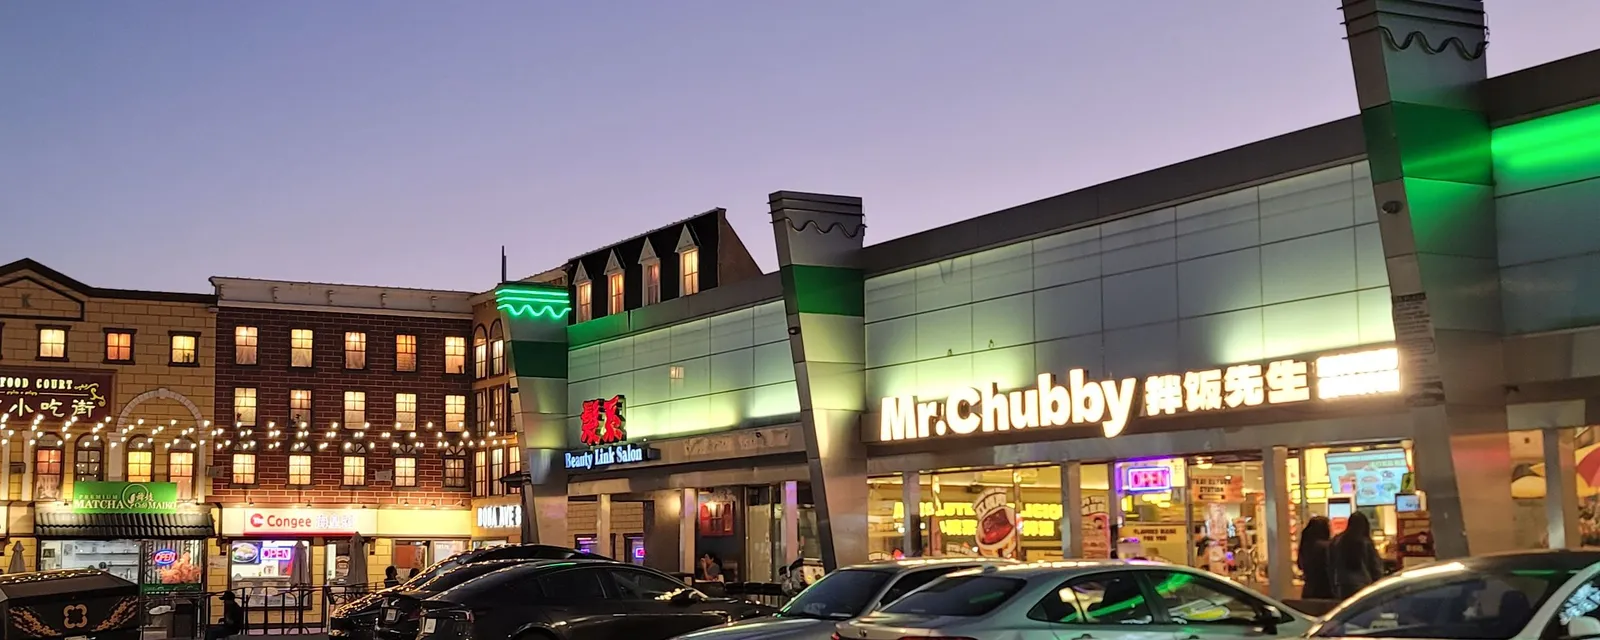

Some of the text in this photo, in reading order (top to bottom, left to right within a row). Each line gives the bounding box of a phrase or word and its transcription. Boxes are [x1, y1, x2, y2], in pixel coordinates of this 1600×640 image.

[0, 376, 73, 390] FOOD COURT
[1144, 360, 1310, 416] 拌饭先生
[0, 397, 96, 418] 小吃街
[565, 444, 643, 470] Beauty Link Salon
[1131, 469, 1169, 487] OPEN
[73, 499, 124, 509] MATCHA
[267, 514, 312, 528] Congee
[155, 552, 176, 562] OPEN
[262, 549, 289, 559] OPEN
